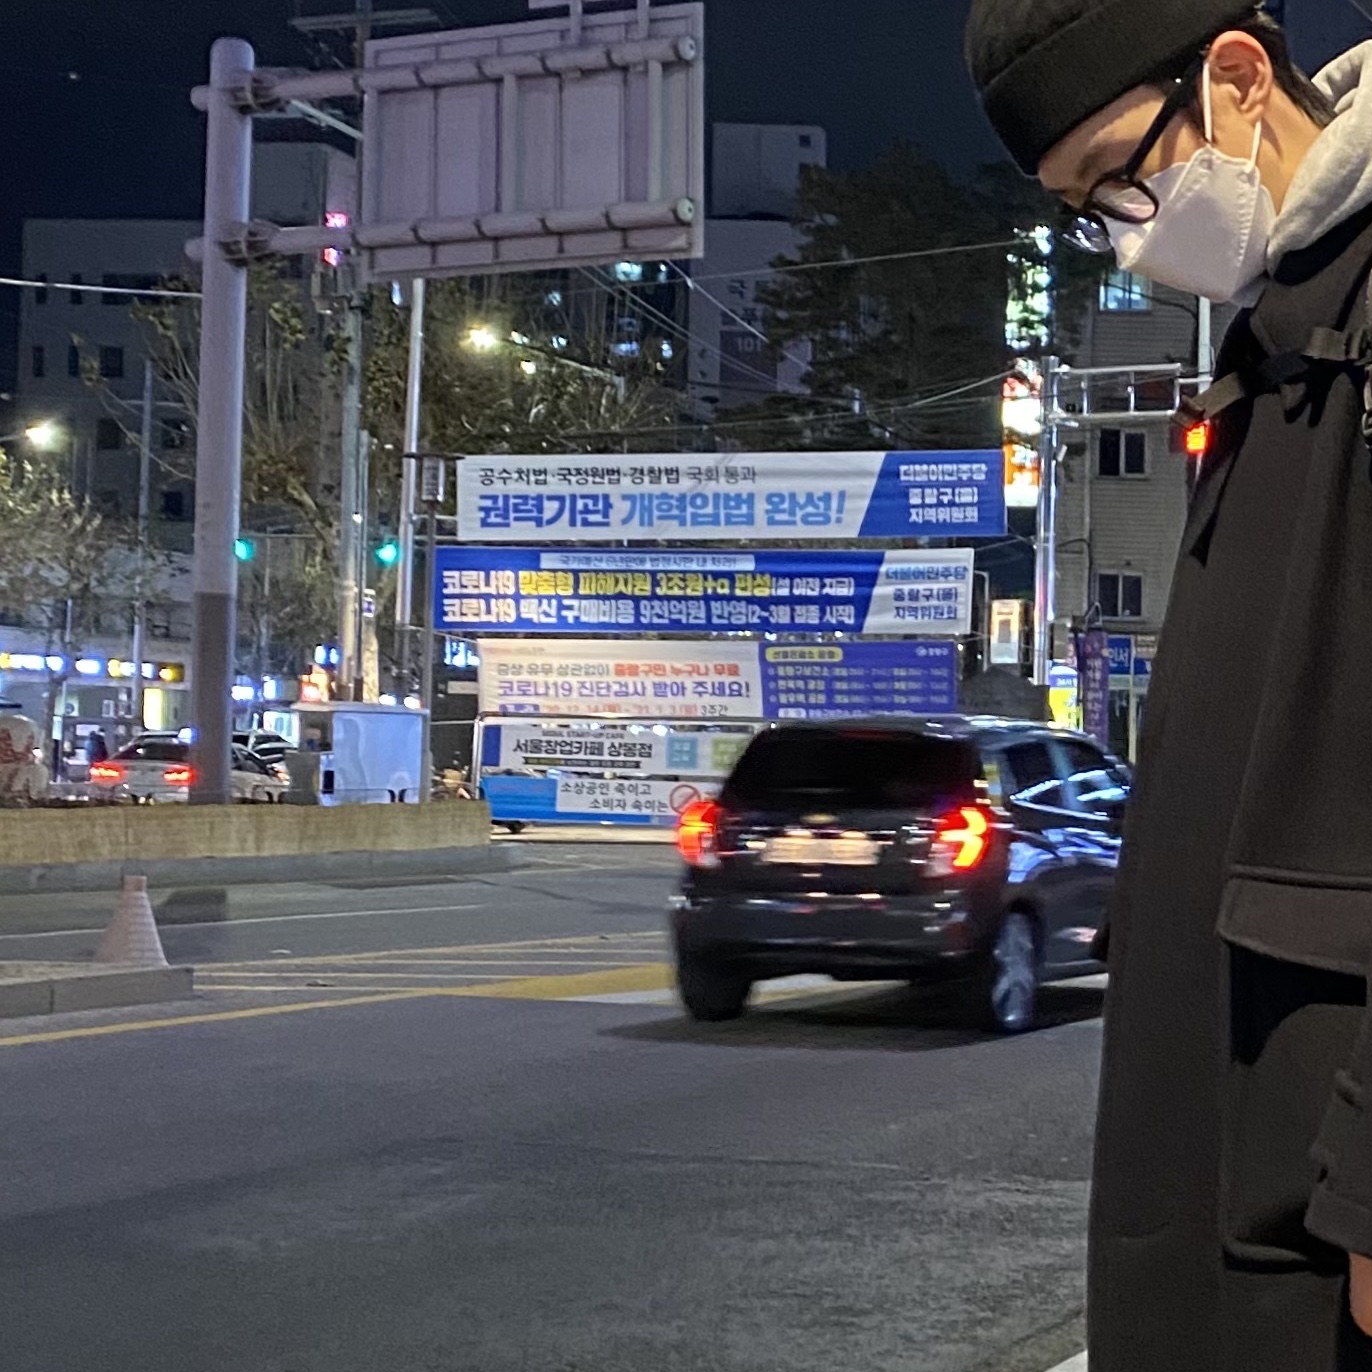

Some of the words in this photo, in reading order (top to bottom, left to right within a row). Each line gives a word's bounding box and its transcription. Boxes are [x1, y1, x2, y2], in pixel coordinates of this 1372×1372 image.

[724, 465, 757, 484] 통과
[899, 463, 988, 482] 더불어민주당
[478, 492, 613, 528] 권력기관
[620, 491, 756, 527] 개혁입법
[764, 489, 846, 527] 완성!
[519, 598, 558, 624] 백신
[556, 663, 611, 676] 상관없이
[497, 680, 573, 699] 코로나19
[578, 680, 647, 699] 진단검사
[651, 680, 687, 699] 받아
[692, 680, 751, 699] 주세요!
[512, 739, 605, 757] 서울창업카페
[560, 782, 611, 796] 소상공인
[614, 783, 652, 796] 죽이고
[588, 797, 627, 812] 소비자
[631, 798, 669, 814] 속이는
